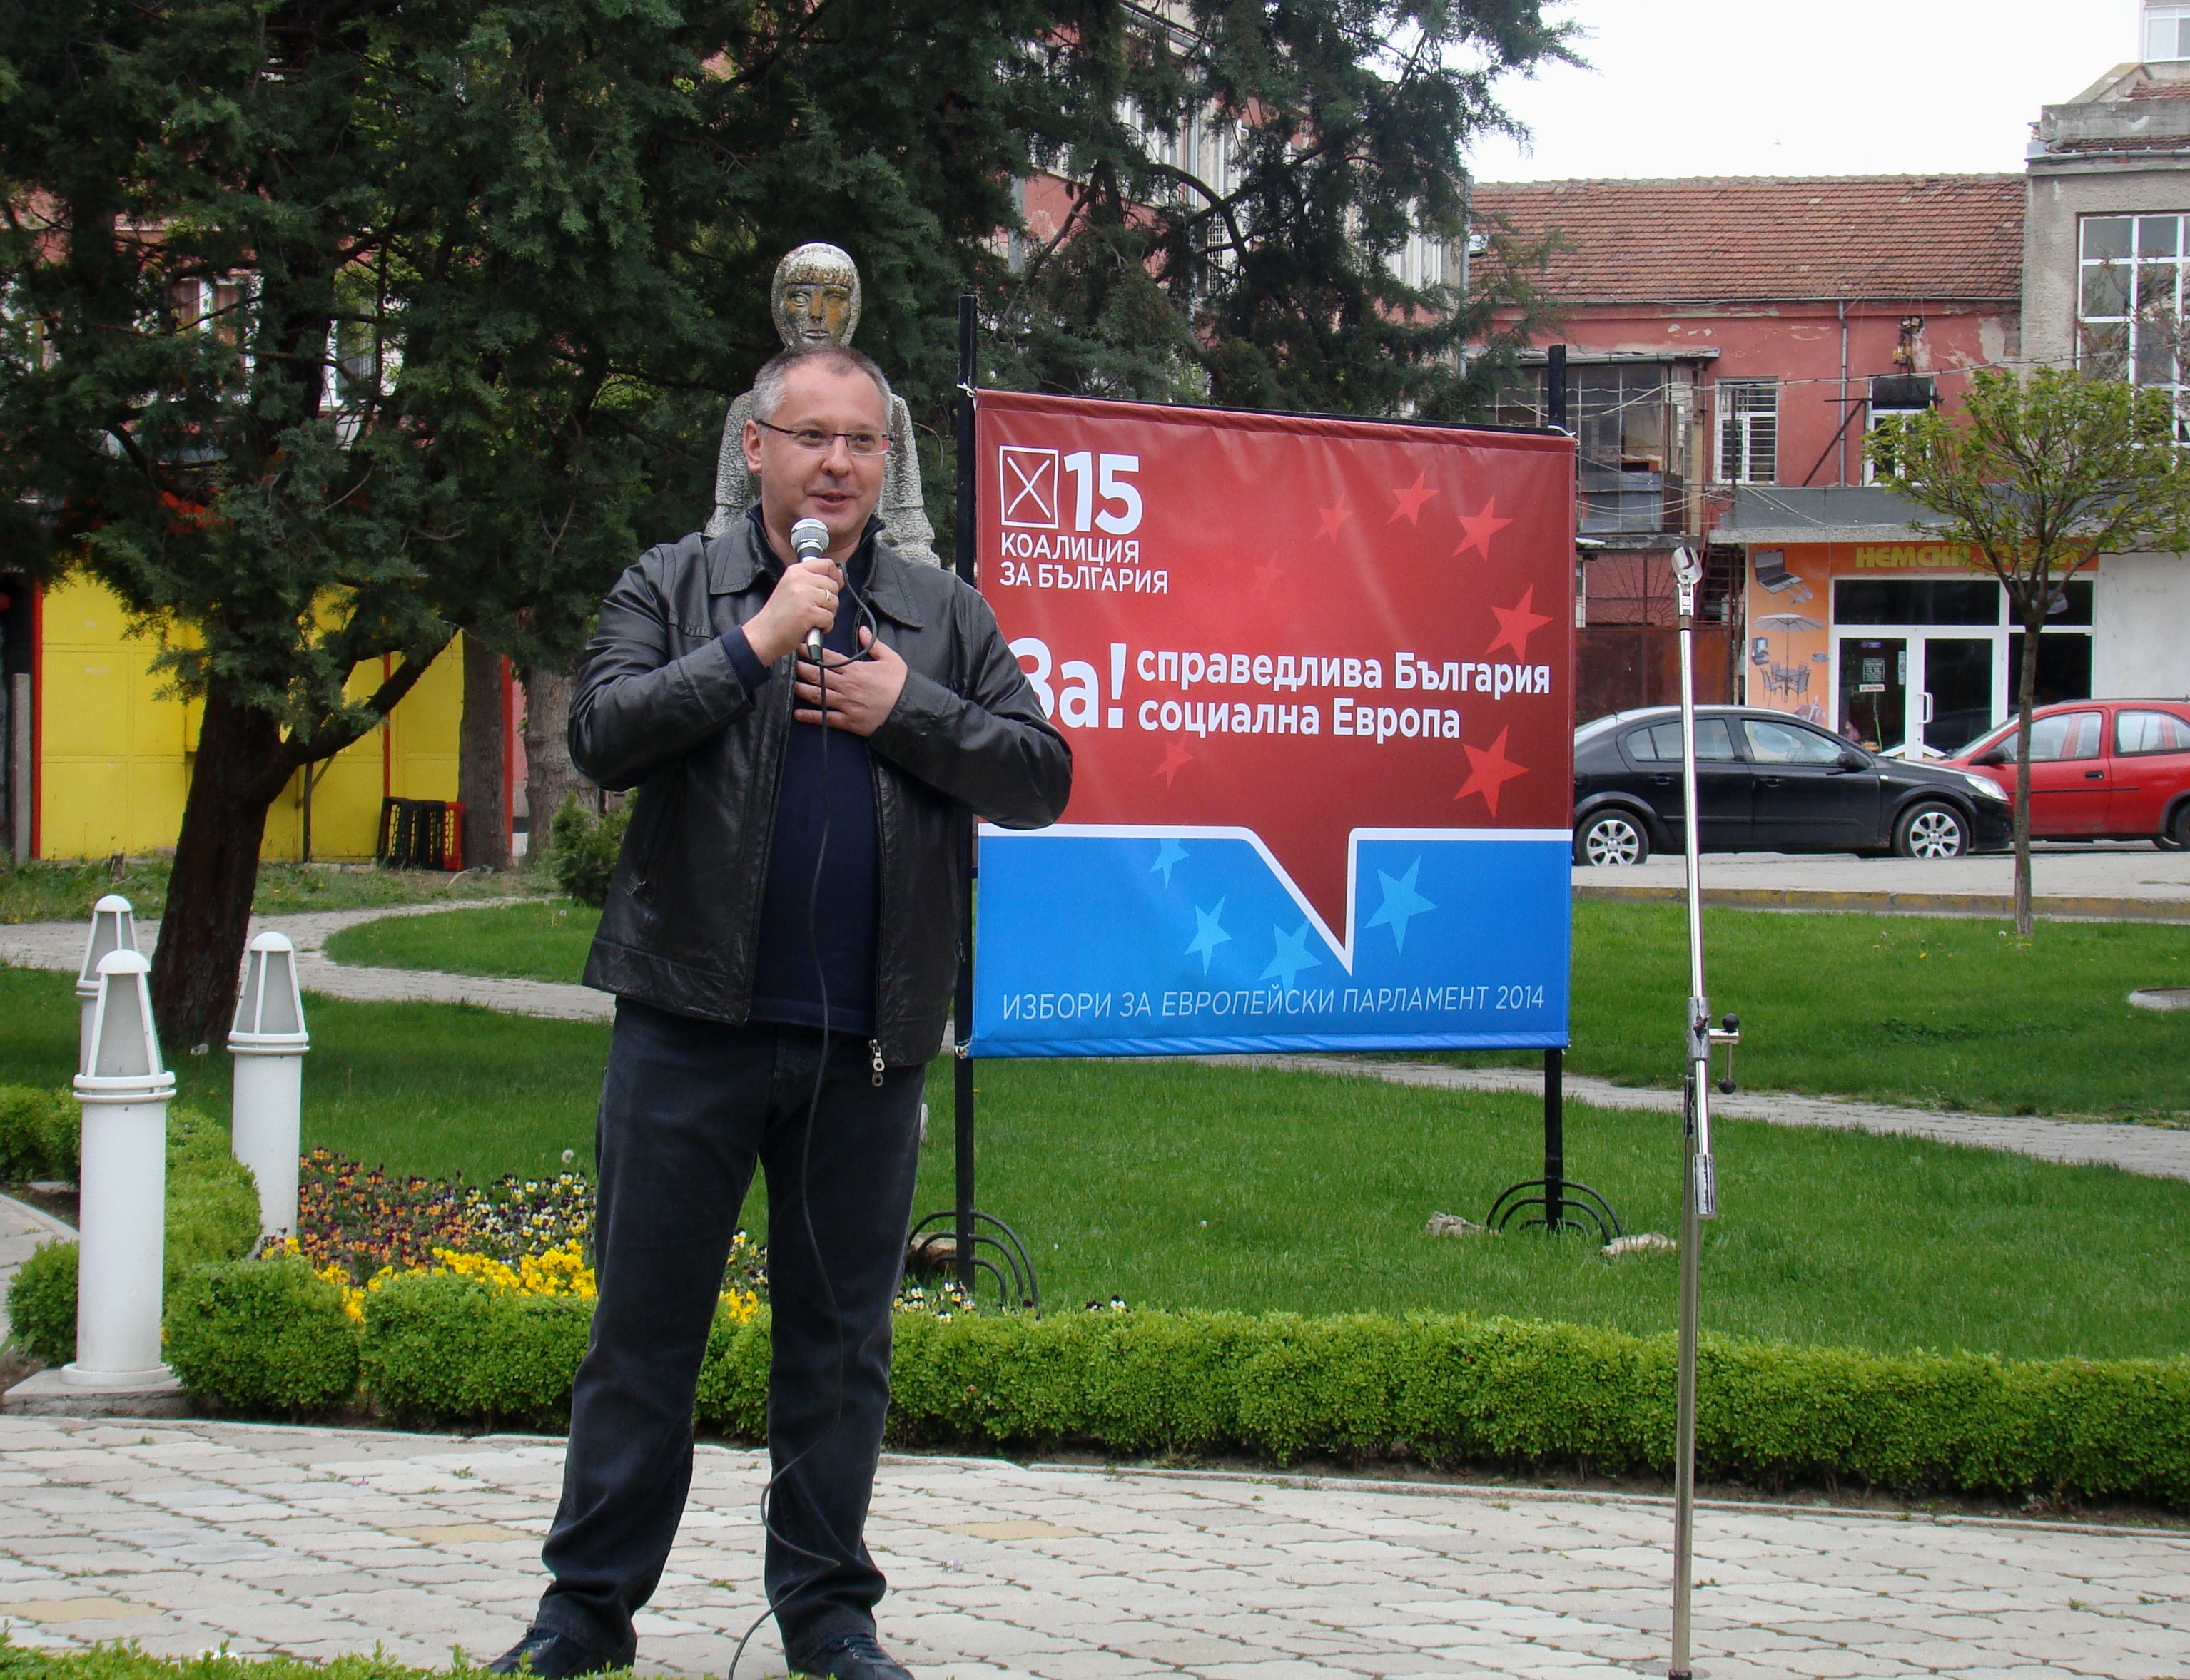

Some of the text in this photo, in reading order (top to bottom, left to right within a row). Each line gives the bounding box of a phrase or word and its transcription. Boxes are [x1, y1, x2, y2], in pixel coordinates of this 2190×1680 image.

[1063, 451, 1143, 535] 15
[1000, 531, 1140, 567] КОАЛИЦИЯ
[999, 561, 1169, 595] ЗА БЪЛГАРИЯ
[1007, 637, 1127, 728] За!
[1137, 650, 1551, 701] справедлива България
[1137, 698, 1461, 745] социална Европа
[1003, 984, 1545, 1020] ИЗБОРИ ЗА ЕВРОПЕЙСКИ ПАРЛАМЕНТ 2014
